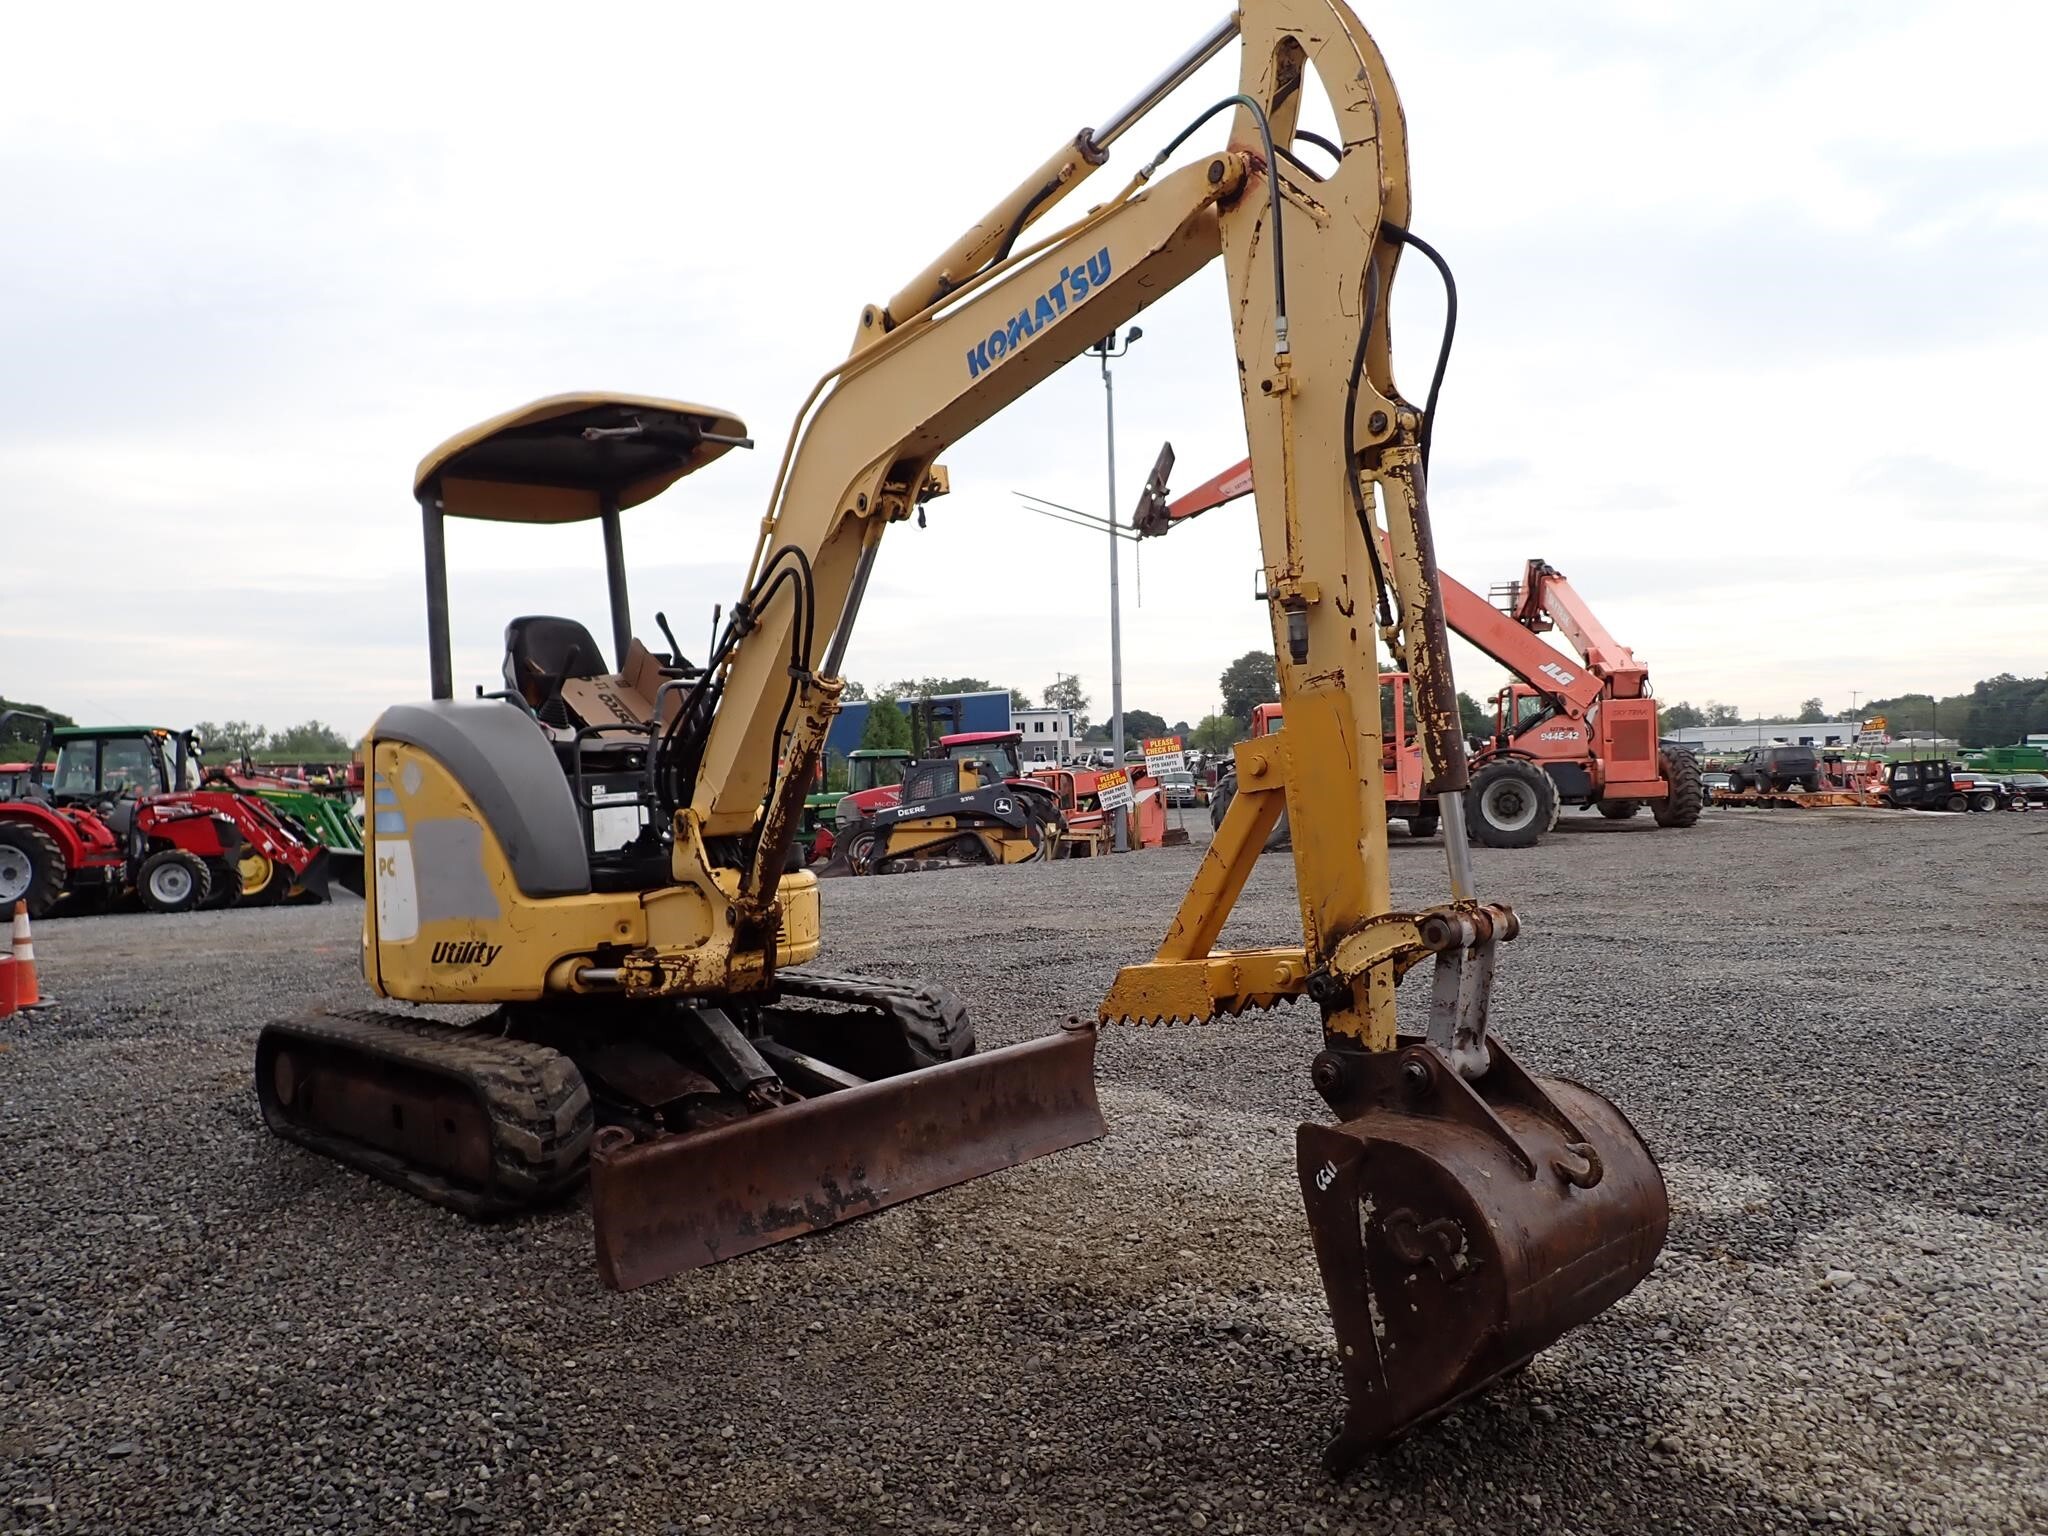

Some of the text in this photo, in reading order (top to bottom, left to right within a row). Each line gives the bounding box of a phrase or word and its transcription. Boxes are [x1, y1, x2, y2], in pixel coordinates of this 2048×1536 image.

[966, 246, 1112, 379] KOMATSU
[1538, 663, 1576, 685] JLG
[1540, 731, 1579, 741] 944E-42
[1145, 744, 1180, 755] CHECK FOR
[1150, 738, 1174, 748] PLEASE
[1097, 776, 1127, 790] CHECK FOR
[1099, 771, 1121, 783] PLEASE
[897, 805, 926, 816] DEERE
[379, 857, 395, 877] PC
[431, 941, 502, 967] Utility
